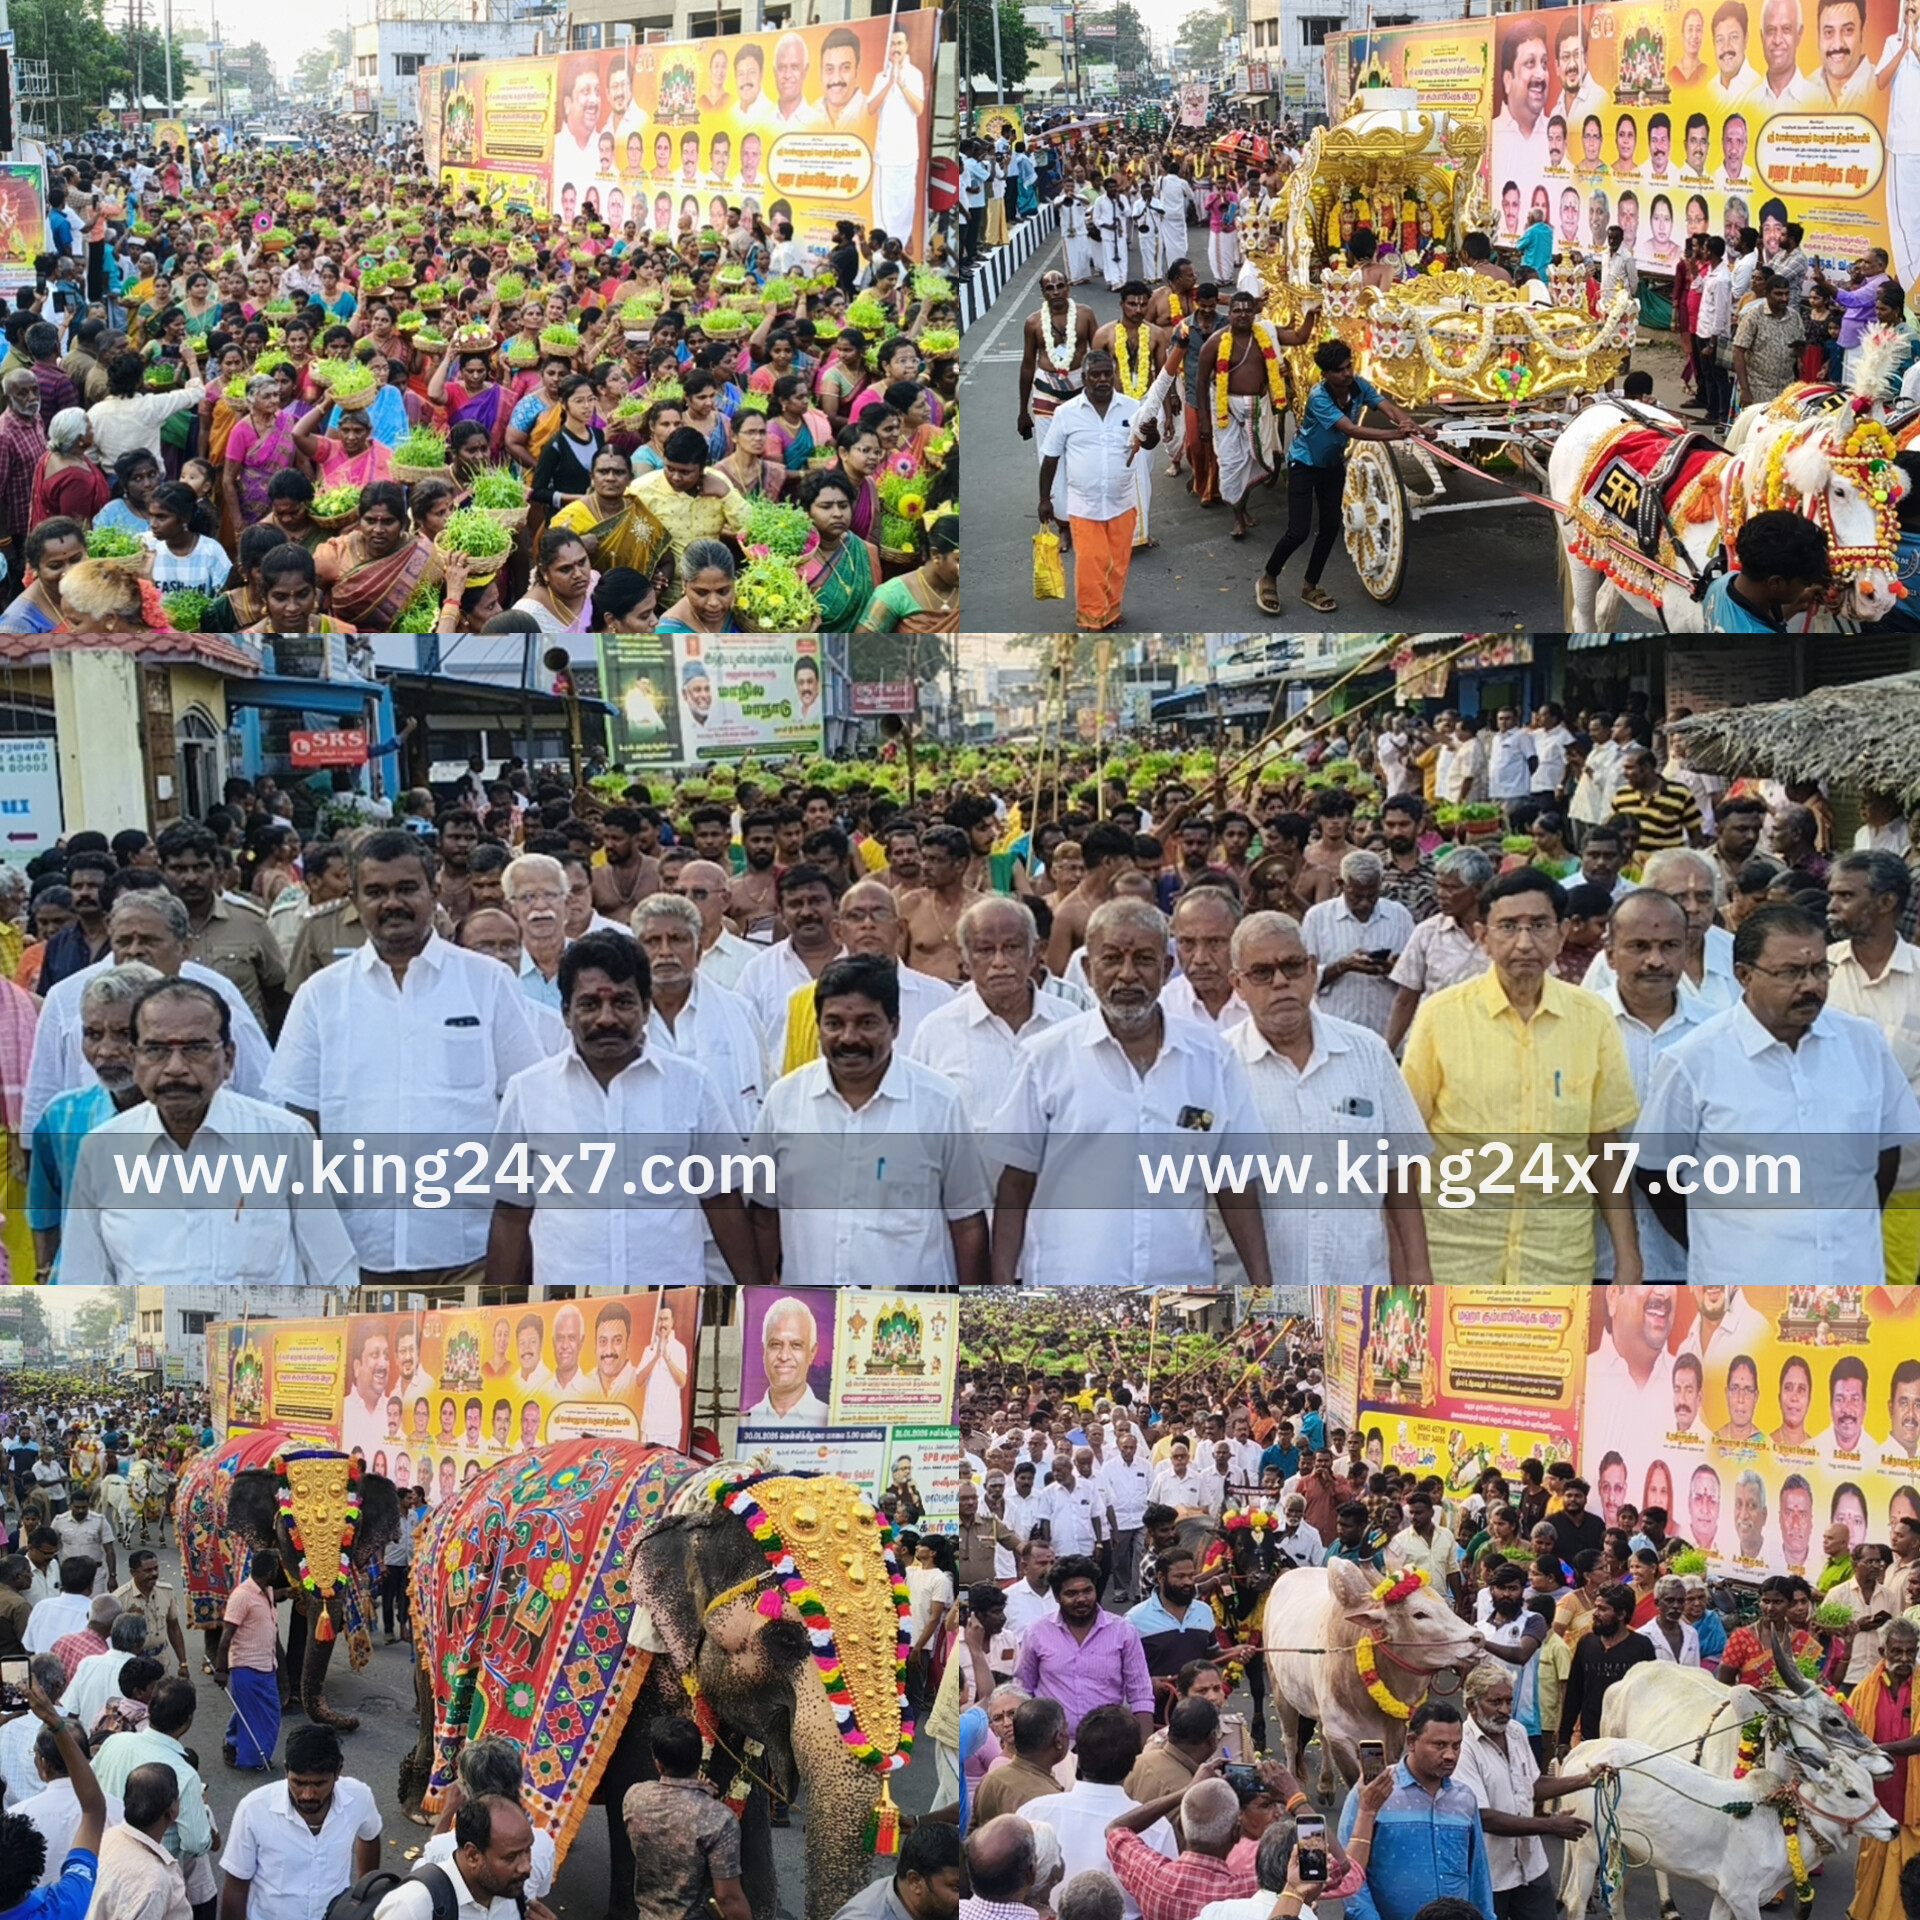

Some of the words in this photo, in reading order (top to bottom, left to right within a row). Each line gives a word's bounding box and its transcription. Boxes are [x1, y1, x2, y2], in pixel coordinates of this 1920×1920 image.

[717, 680, 765, 702] மாநில
[741, 698, 792, 718] மாநாடு
[312, 732, 363, 747] SRS
[923, 1452, 939, 1463] SPB
